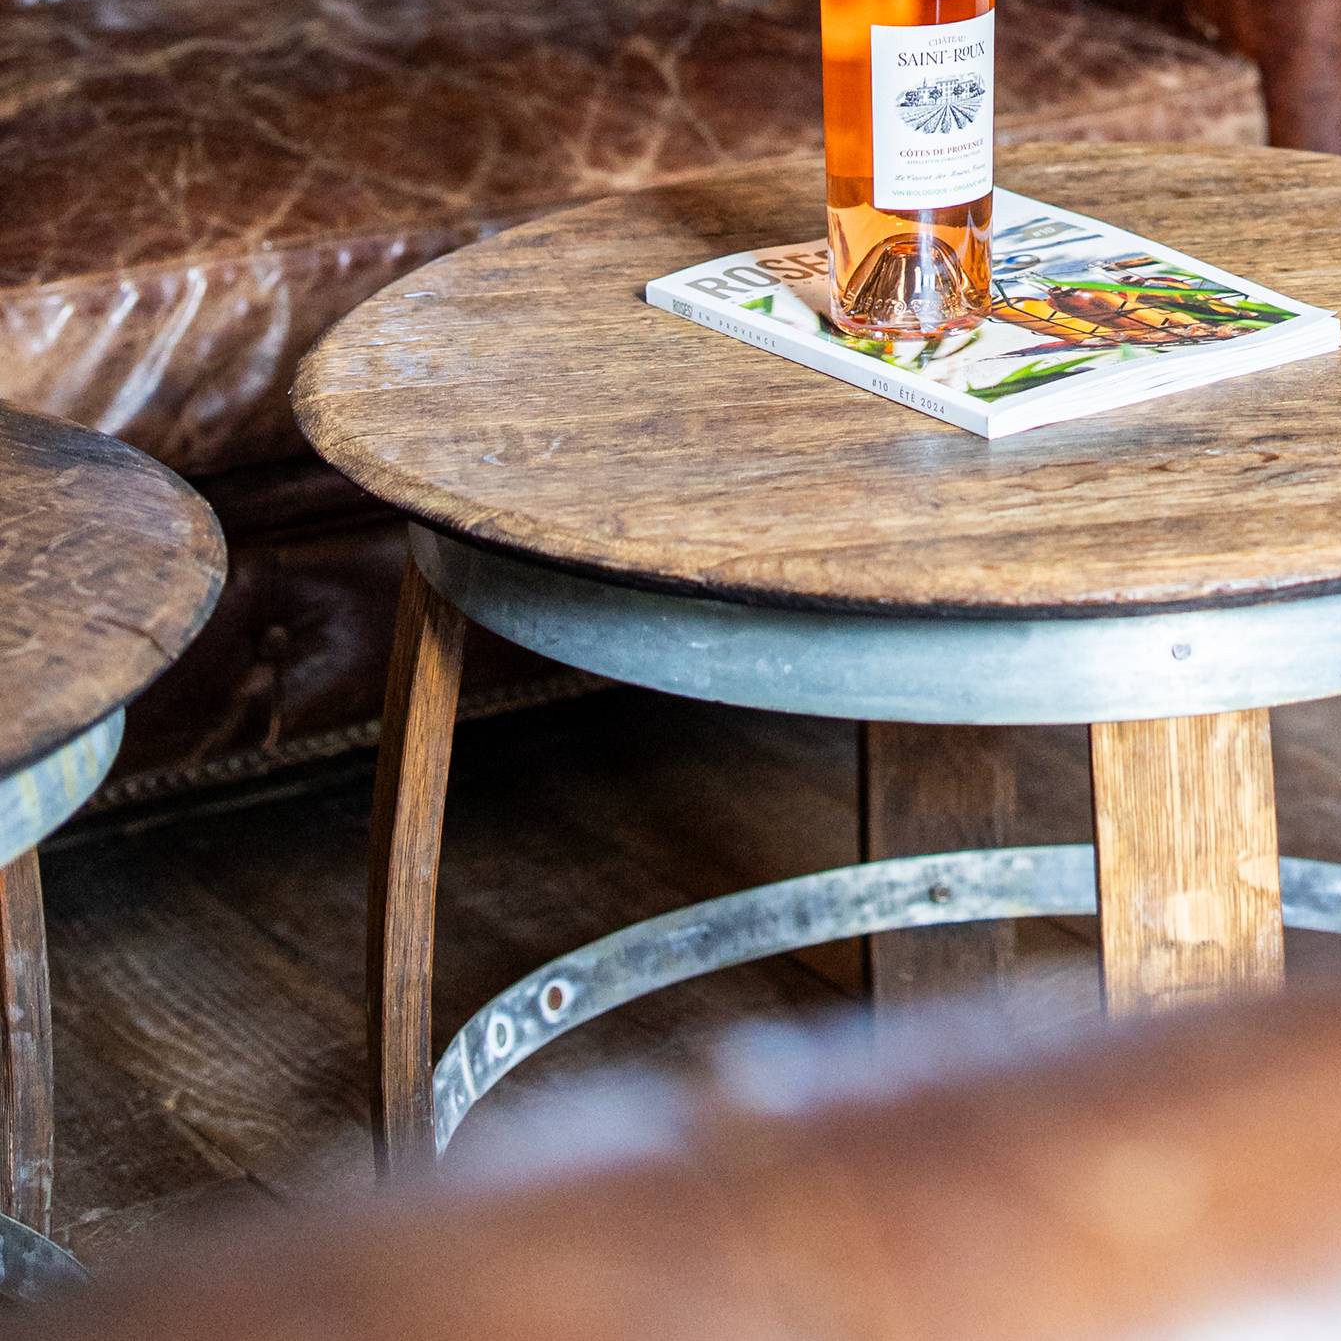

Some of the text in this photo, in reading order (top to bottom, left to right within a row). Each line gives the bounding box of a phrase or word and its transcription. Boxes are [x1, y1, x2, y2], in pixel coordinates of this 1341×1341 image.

[898, 41, 985, 66] SAINT-ROUX
[899, 148, 930, 158] CÔTES
[947, 138, 984, 154] PROVENCE
[720, 320, 776, 348] PROVENCE
[872, 379, 888, 392] #10
[899, 386, 916, 403] ÉTÉ
[921, 398, 945, 414] 2024
